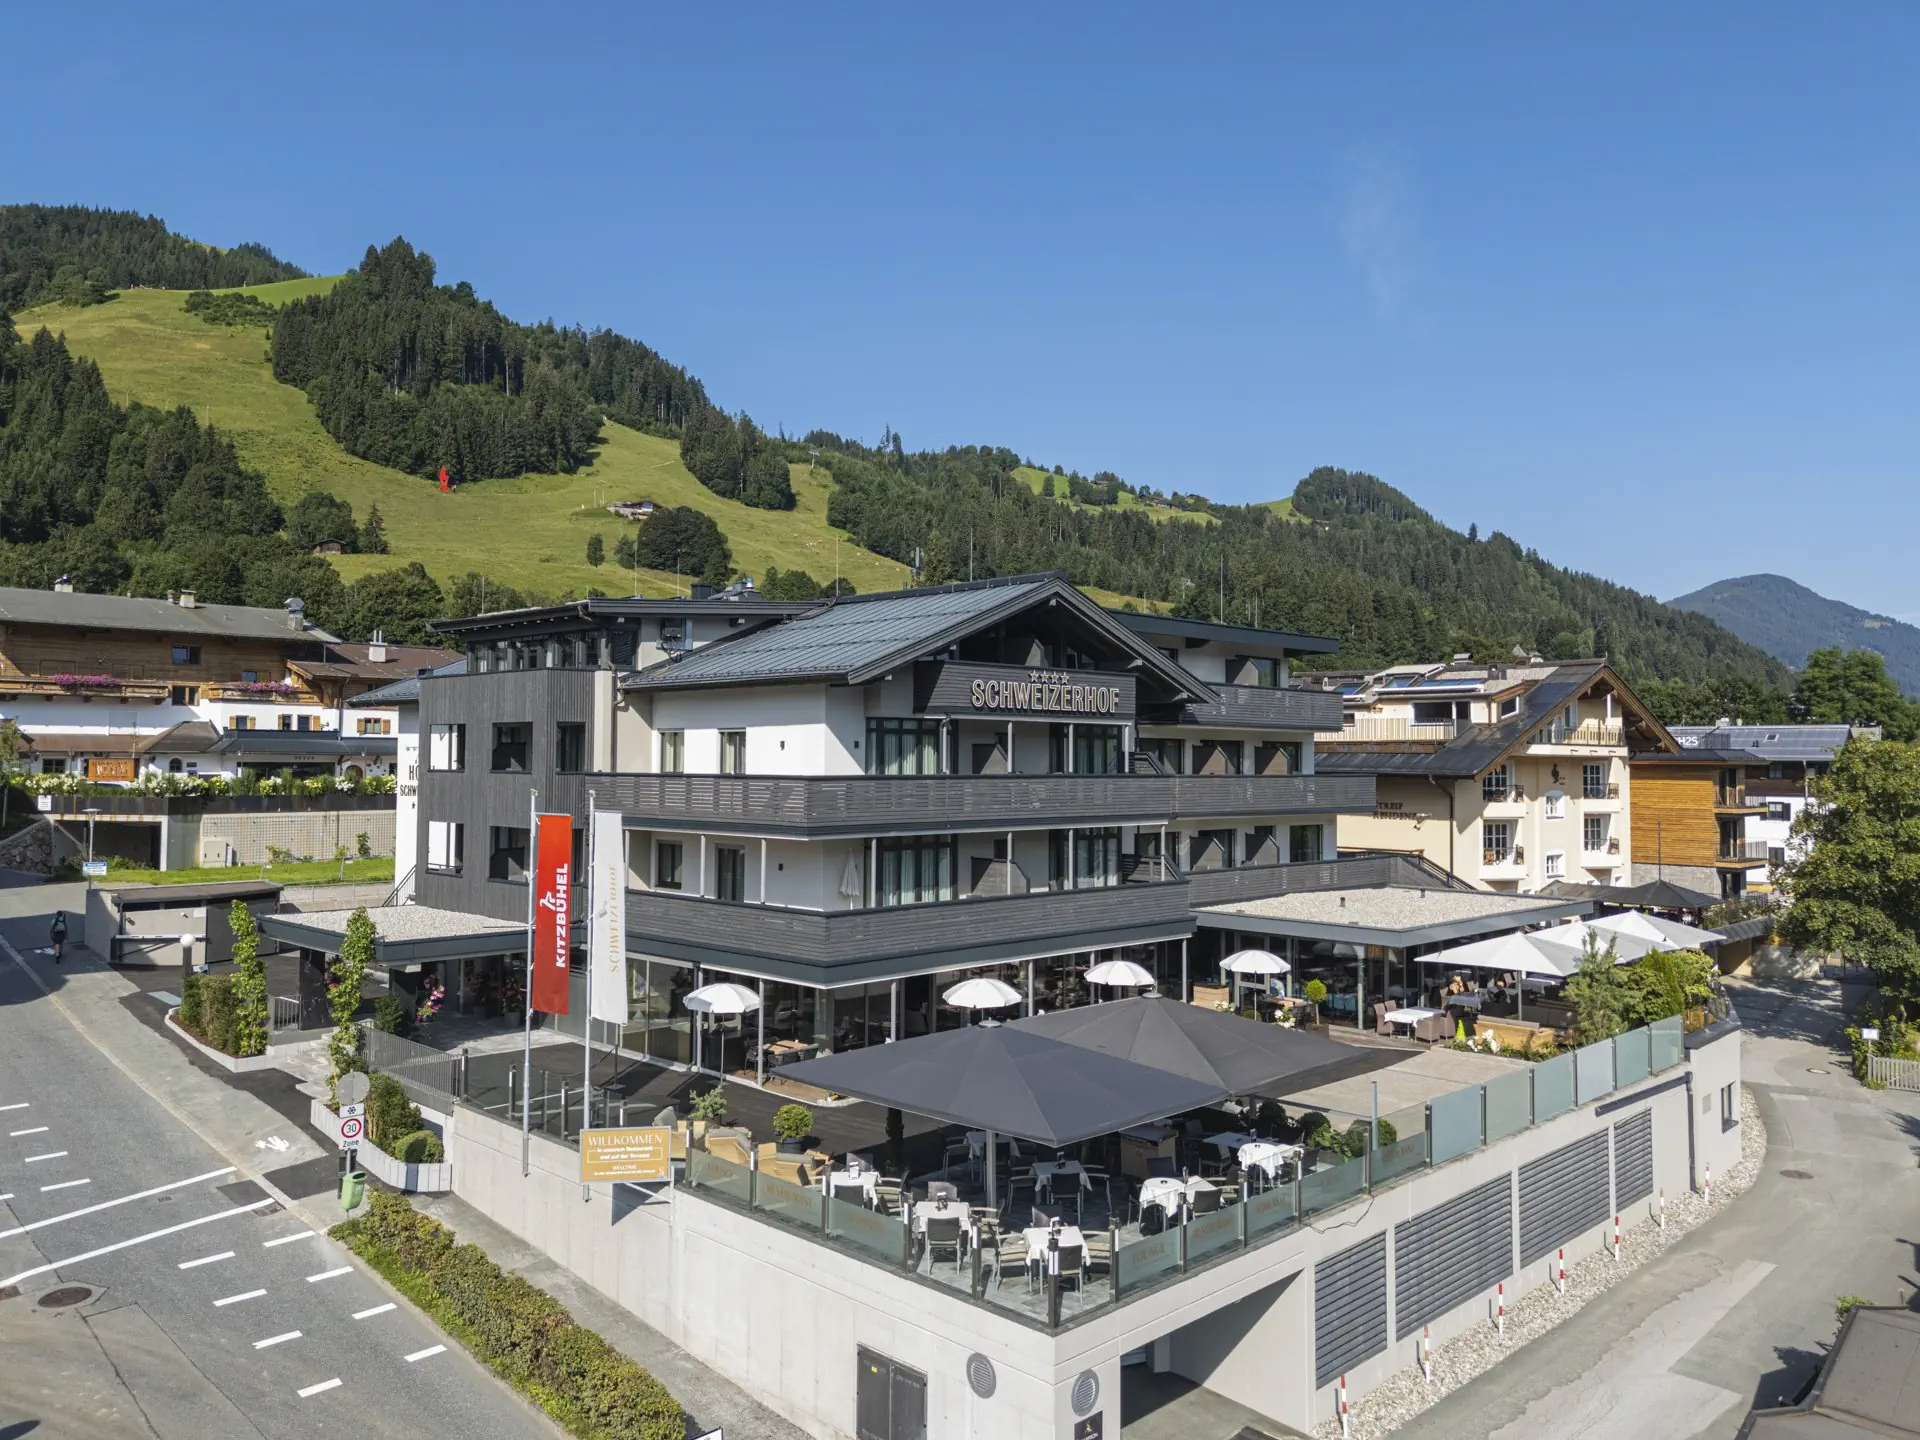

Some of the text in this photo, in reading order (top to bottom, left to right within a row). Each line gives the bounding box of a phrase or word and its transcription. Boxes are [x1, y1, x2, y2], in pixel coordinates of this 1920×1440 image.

[972, 679, 1120, 713] SCHWEIZERHOF
[555, 863, 568, 968] KITZBÜHEL
[346, 1123, 357, 1134] 30
[343, 1139, 360, 1148] Zone
[588, 1133, 662, 1146] WILLKOMMEN
